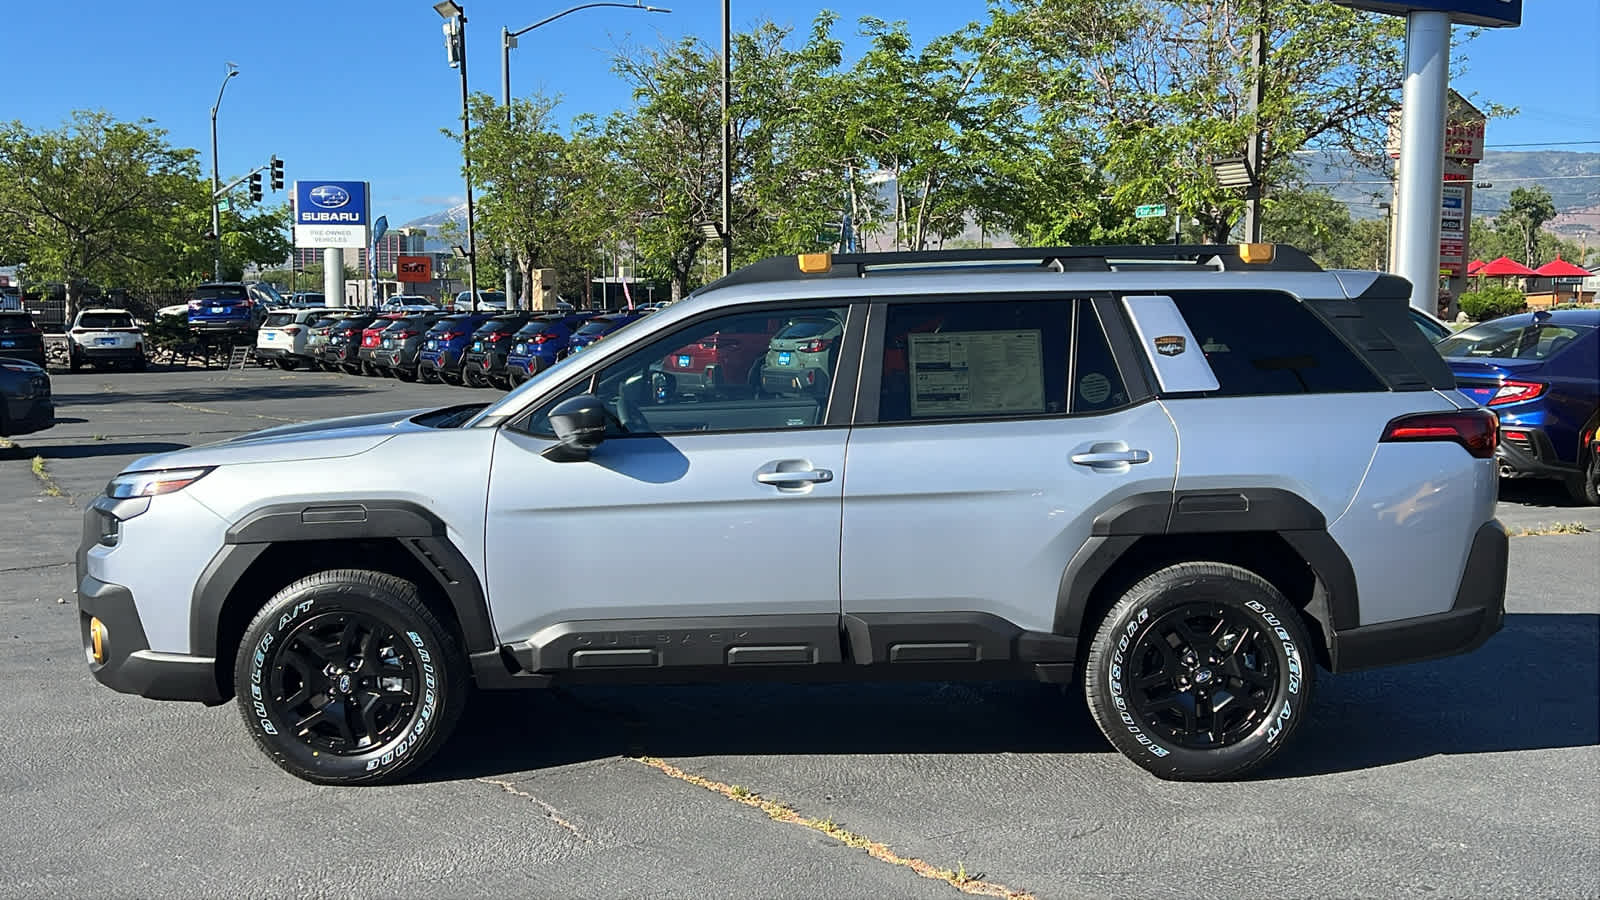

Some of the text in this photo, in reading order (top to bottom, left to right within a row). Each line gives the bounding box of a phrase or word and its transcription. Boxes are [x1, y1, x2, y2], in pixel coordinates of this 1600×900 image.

[302, 212, 360, 221] SUBARU
[251, 599, 314, 735] DUELER A/T
[366, 631, 439, 771] BRIDGESTONE
[575, 631, 750, 647] OUTBACK
[1109, 608, 1171, 758] BRIDGESTONE
[1245, 600, 1301, 744] DUELER A/T
